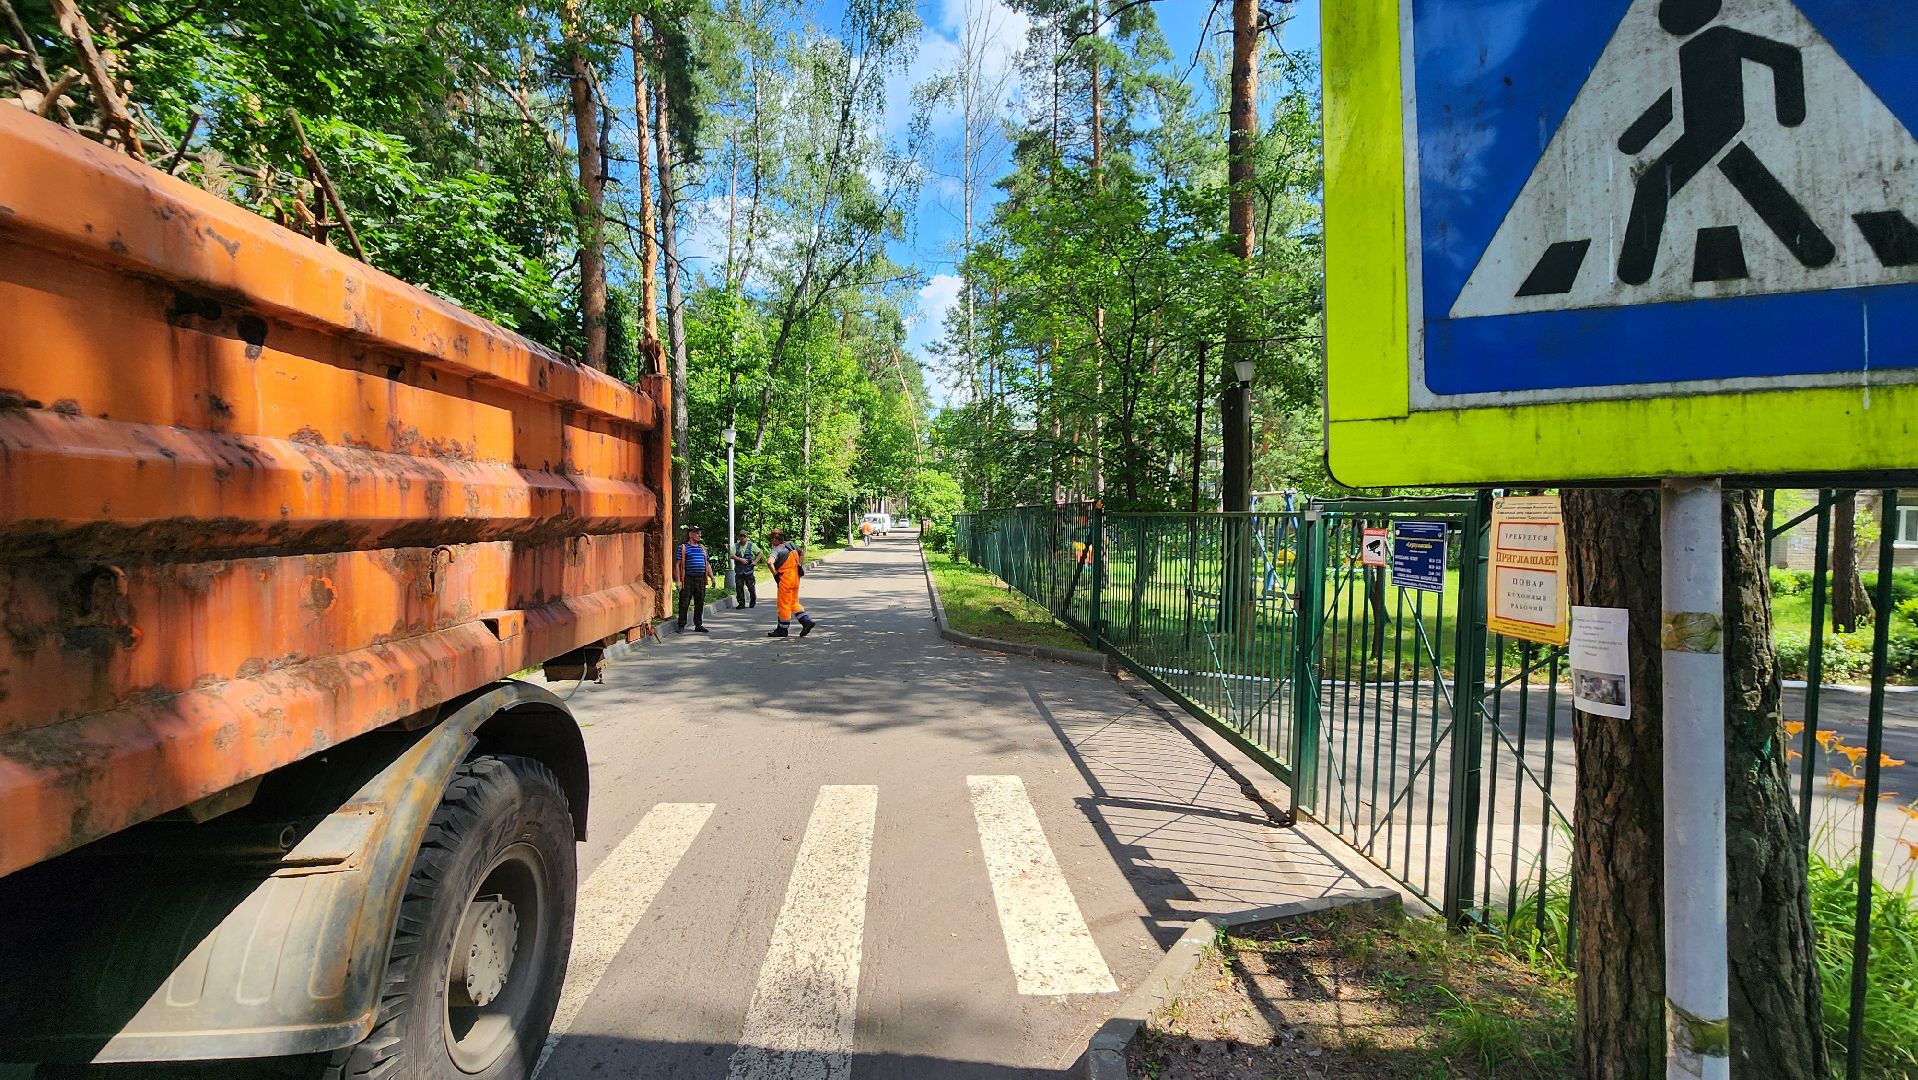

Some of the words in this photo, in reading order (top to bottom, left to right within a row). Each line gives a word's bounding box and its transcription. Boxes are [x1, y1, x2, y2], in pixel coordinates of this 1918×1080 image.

[1505, 533, 1548, 541] ТРЕБУЕТСЯ
[1496, 552, 1559, 566] ПРИГЛАШАЕТ!
[1512, 577, 1544, 587] ПОВАР
